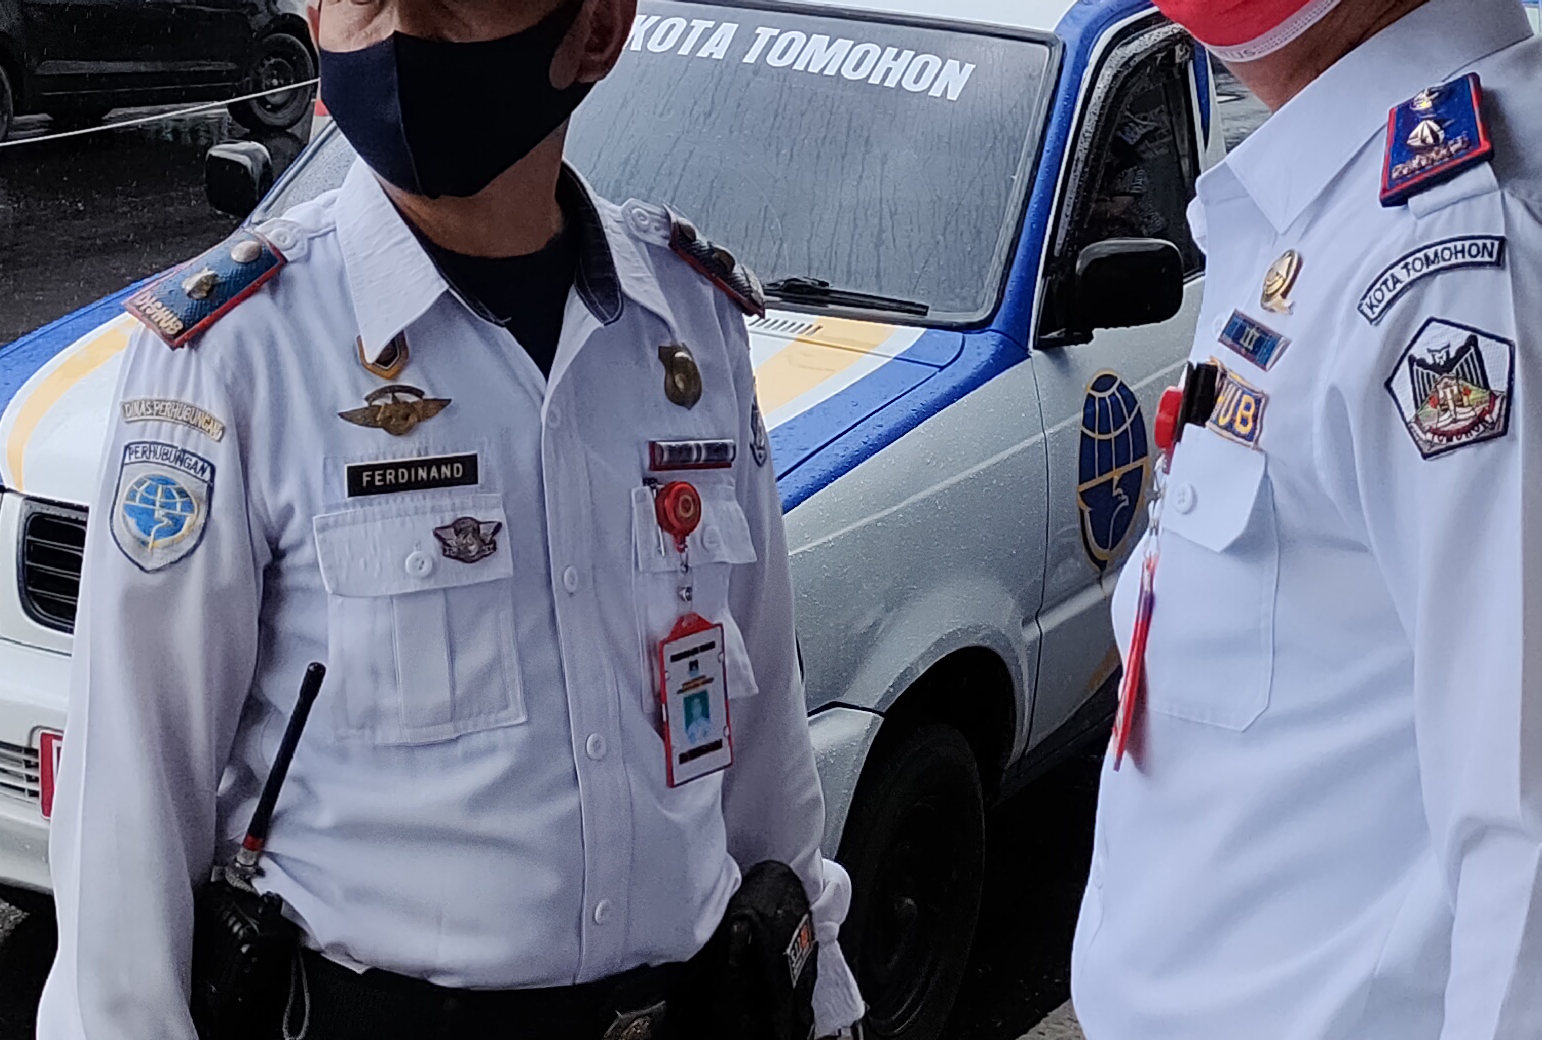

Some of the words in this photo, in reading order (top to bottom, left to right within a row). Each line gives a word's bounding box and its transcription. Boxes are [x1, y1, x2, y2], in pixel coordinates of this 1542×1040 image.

[625, 13, 739, 60] KOTA
[742, 26, 976, 102] TOMOHON
[1365, 273, 1402, 315] KOTA
[1401, 241, 1496, 278] TOMOHON
[124, 401, 152, 419] DINAS
[152, 401, 225, 441] PERHUBUNGAN
[128, 444, 209, 478] PERHUBUNGAN
[362, 462, 464, 488] FERDINAND
